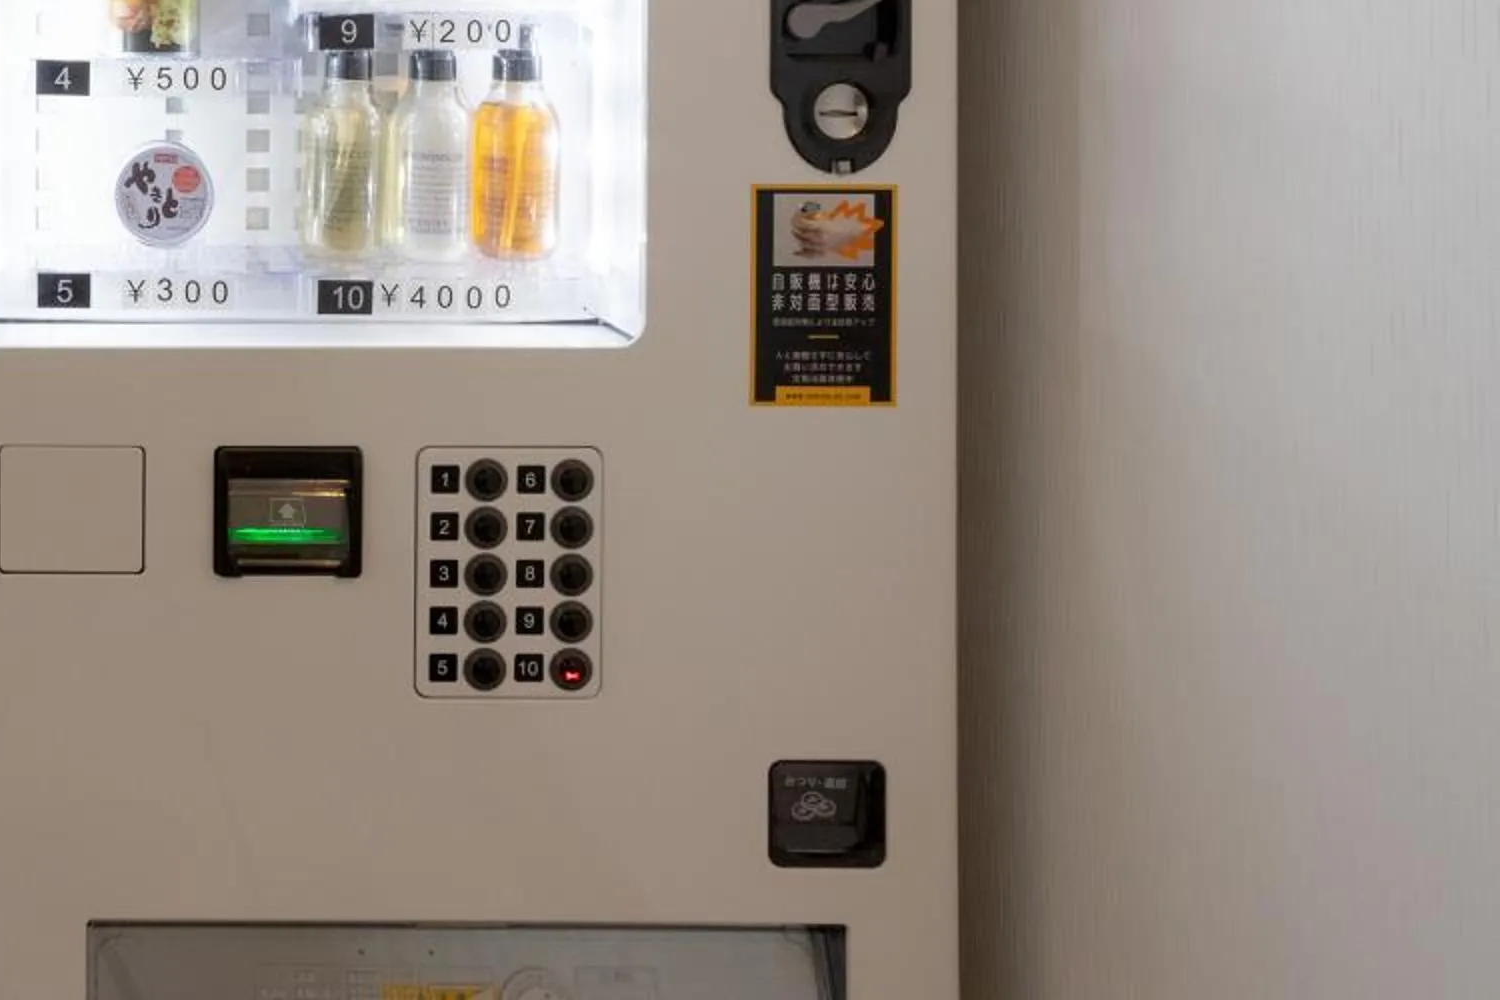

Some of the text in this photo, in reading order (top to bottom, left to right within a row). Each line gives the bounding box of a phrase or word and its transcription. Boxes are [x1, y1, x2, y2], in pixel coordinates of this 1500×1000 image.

[341, 18, 357, 43] 9
[410, 18, 511, 43] ¥200
[53, 67, 72, 91] 4
[127, 67, 227, 91] ¥500
[56, 279, 73, 303] 5
[127, 278, 228, 304] ¥300
[332, 286, 365, 311] 10
[380, 283, 510, 309] ¥4000
[441, 472, 449, 487] 1
[525, 472, 537, 488] 6
[439, 519, 450, 534] 2
[525, 519, 536, 534] 7
[439, 566, 449, 581] 3
[525, 566, 535, 581] 8
[437, 613, 448, 629] 4
[524, 613, 534, 629] 9
[437, 660, 448, 675] 5
[518, 660, 539, 676] 10
